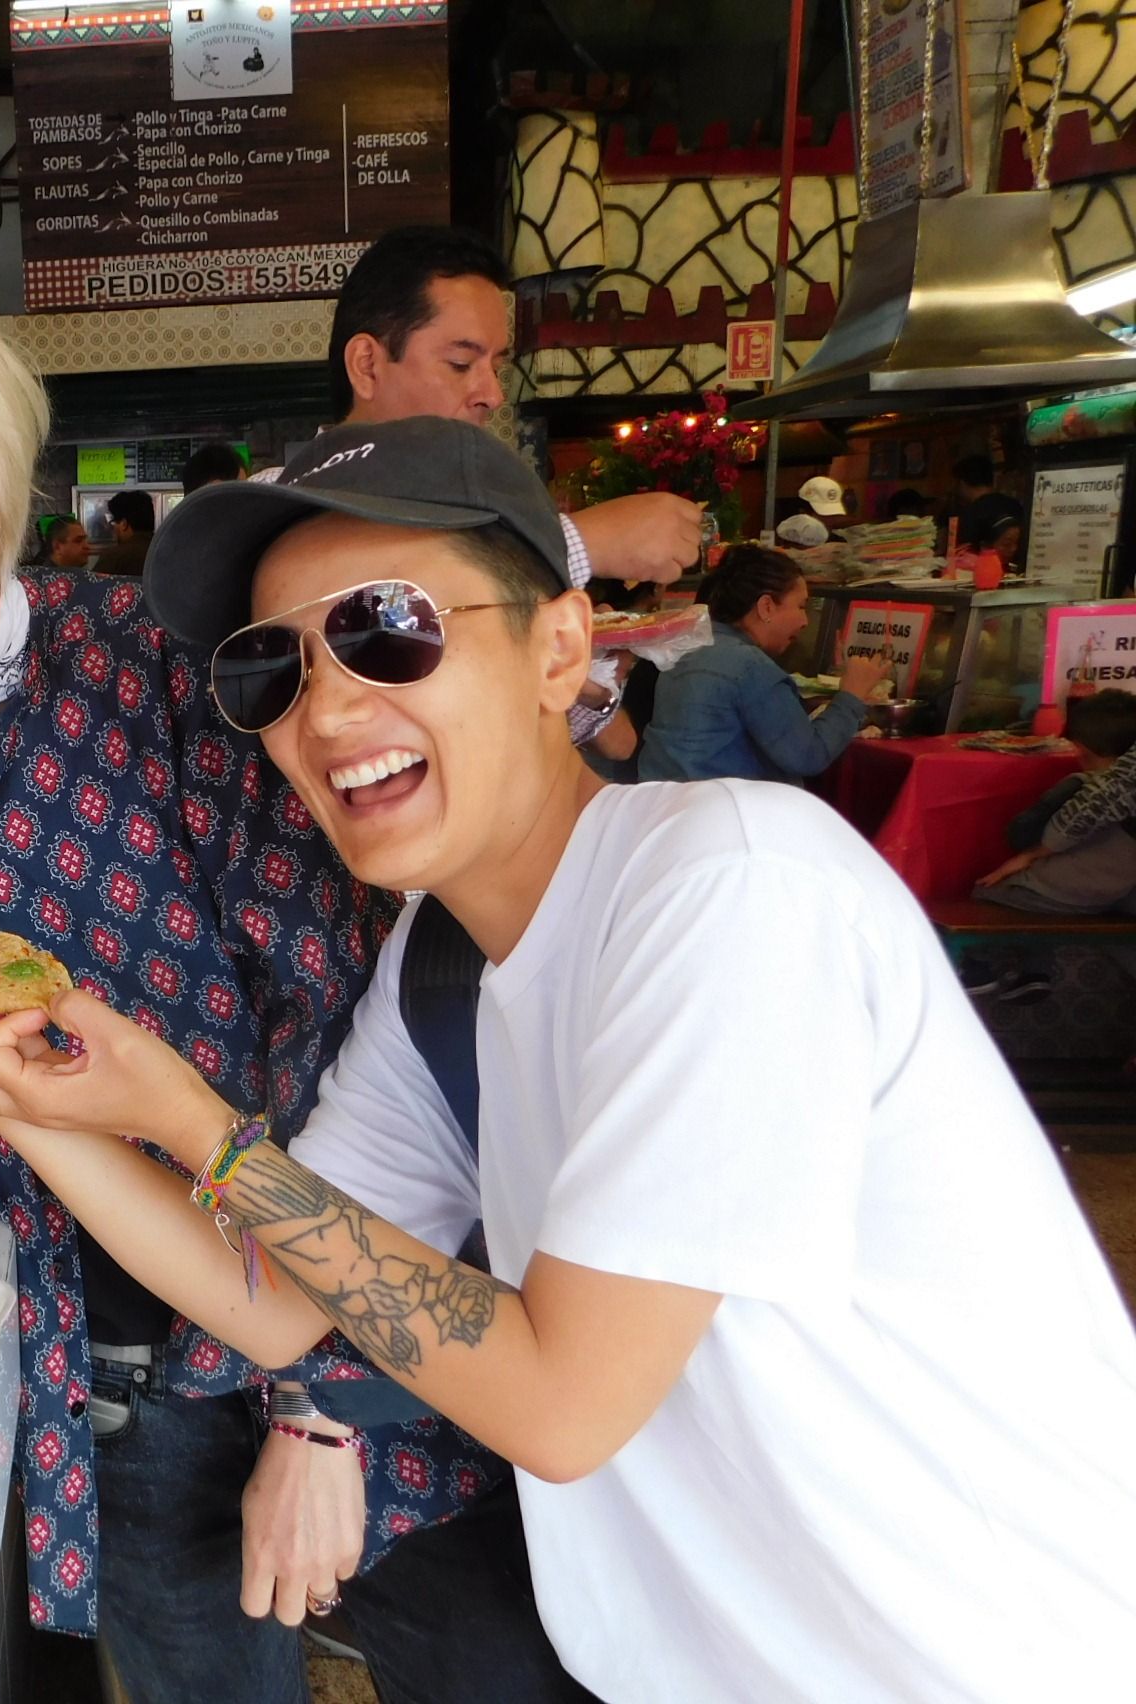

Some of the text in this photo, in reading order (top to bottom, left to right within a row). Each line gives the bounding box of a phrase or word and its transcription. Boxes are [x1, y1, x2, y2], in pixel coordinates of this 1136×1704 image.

[228, 21, 275, 40] MEXICANOS
[233, 35, 261, 46] LUPITA
[29, 113, 103, 130] TOSTADAS DE
[179, 109, 213, 125] Tinga
[251, 105, 288, 119] Carne
[33, 127, 103, 145] PAMBASOS
[194, 121, 242, 137] Chorizo
[42, 155, 83, 172] SOPES
[190, 153, 205, 167] de
[208, 152, 239, 167] Pollo
[248, 150, 284, 165] Carne
[286, 153, 294, 165] y
[295, 147, 330, 164] Tinga
[171, 176, 193, 188] con
[196, 171, 243, 186] Chorizo
[358, 169, 411, 185] DE OLLA
[34, 184, 89, 200] FLAUTAS
[173, 196, 180, 208] y
[182, 192, 219, 205] Carne
[36, 215, 100, 231] GORDITAS
[193, 214, 201, 225] o
[203, 208, 279, 225] Combinadas
[101, 260, 164, 274] HIGUERA
[195, 256, 222, 267] 10-6
[254, 266, 288, 289] 55
[298, 262, 348, 287] 549
